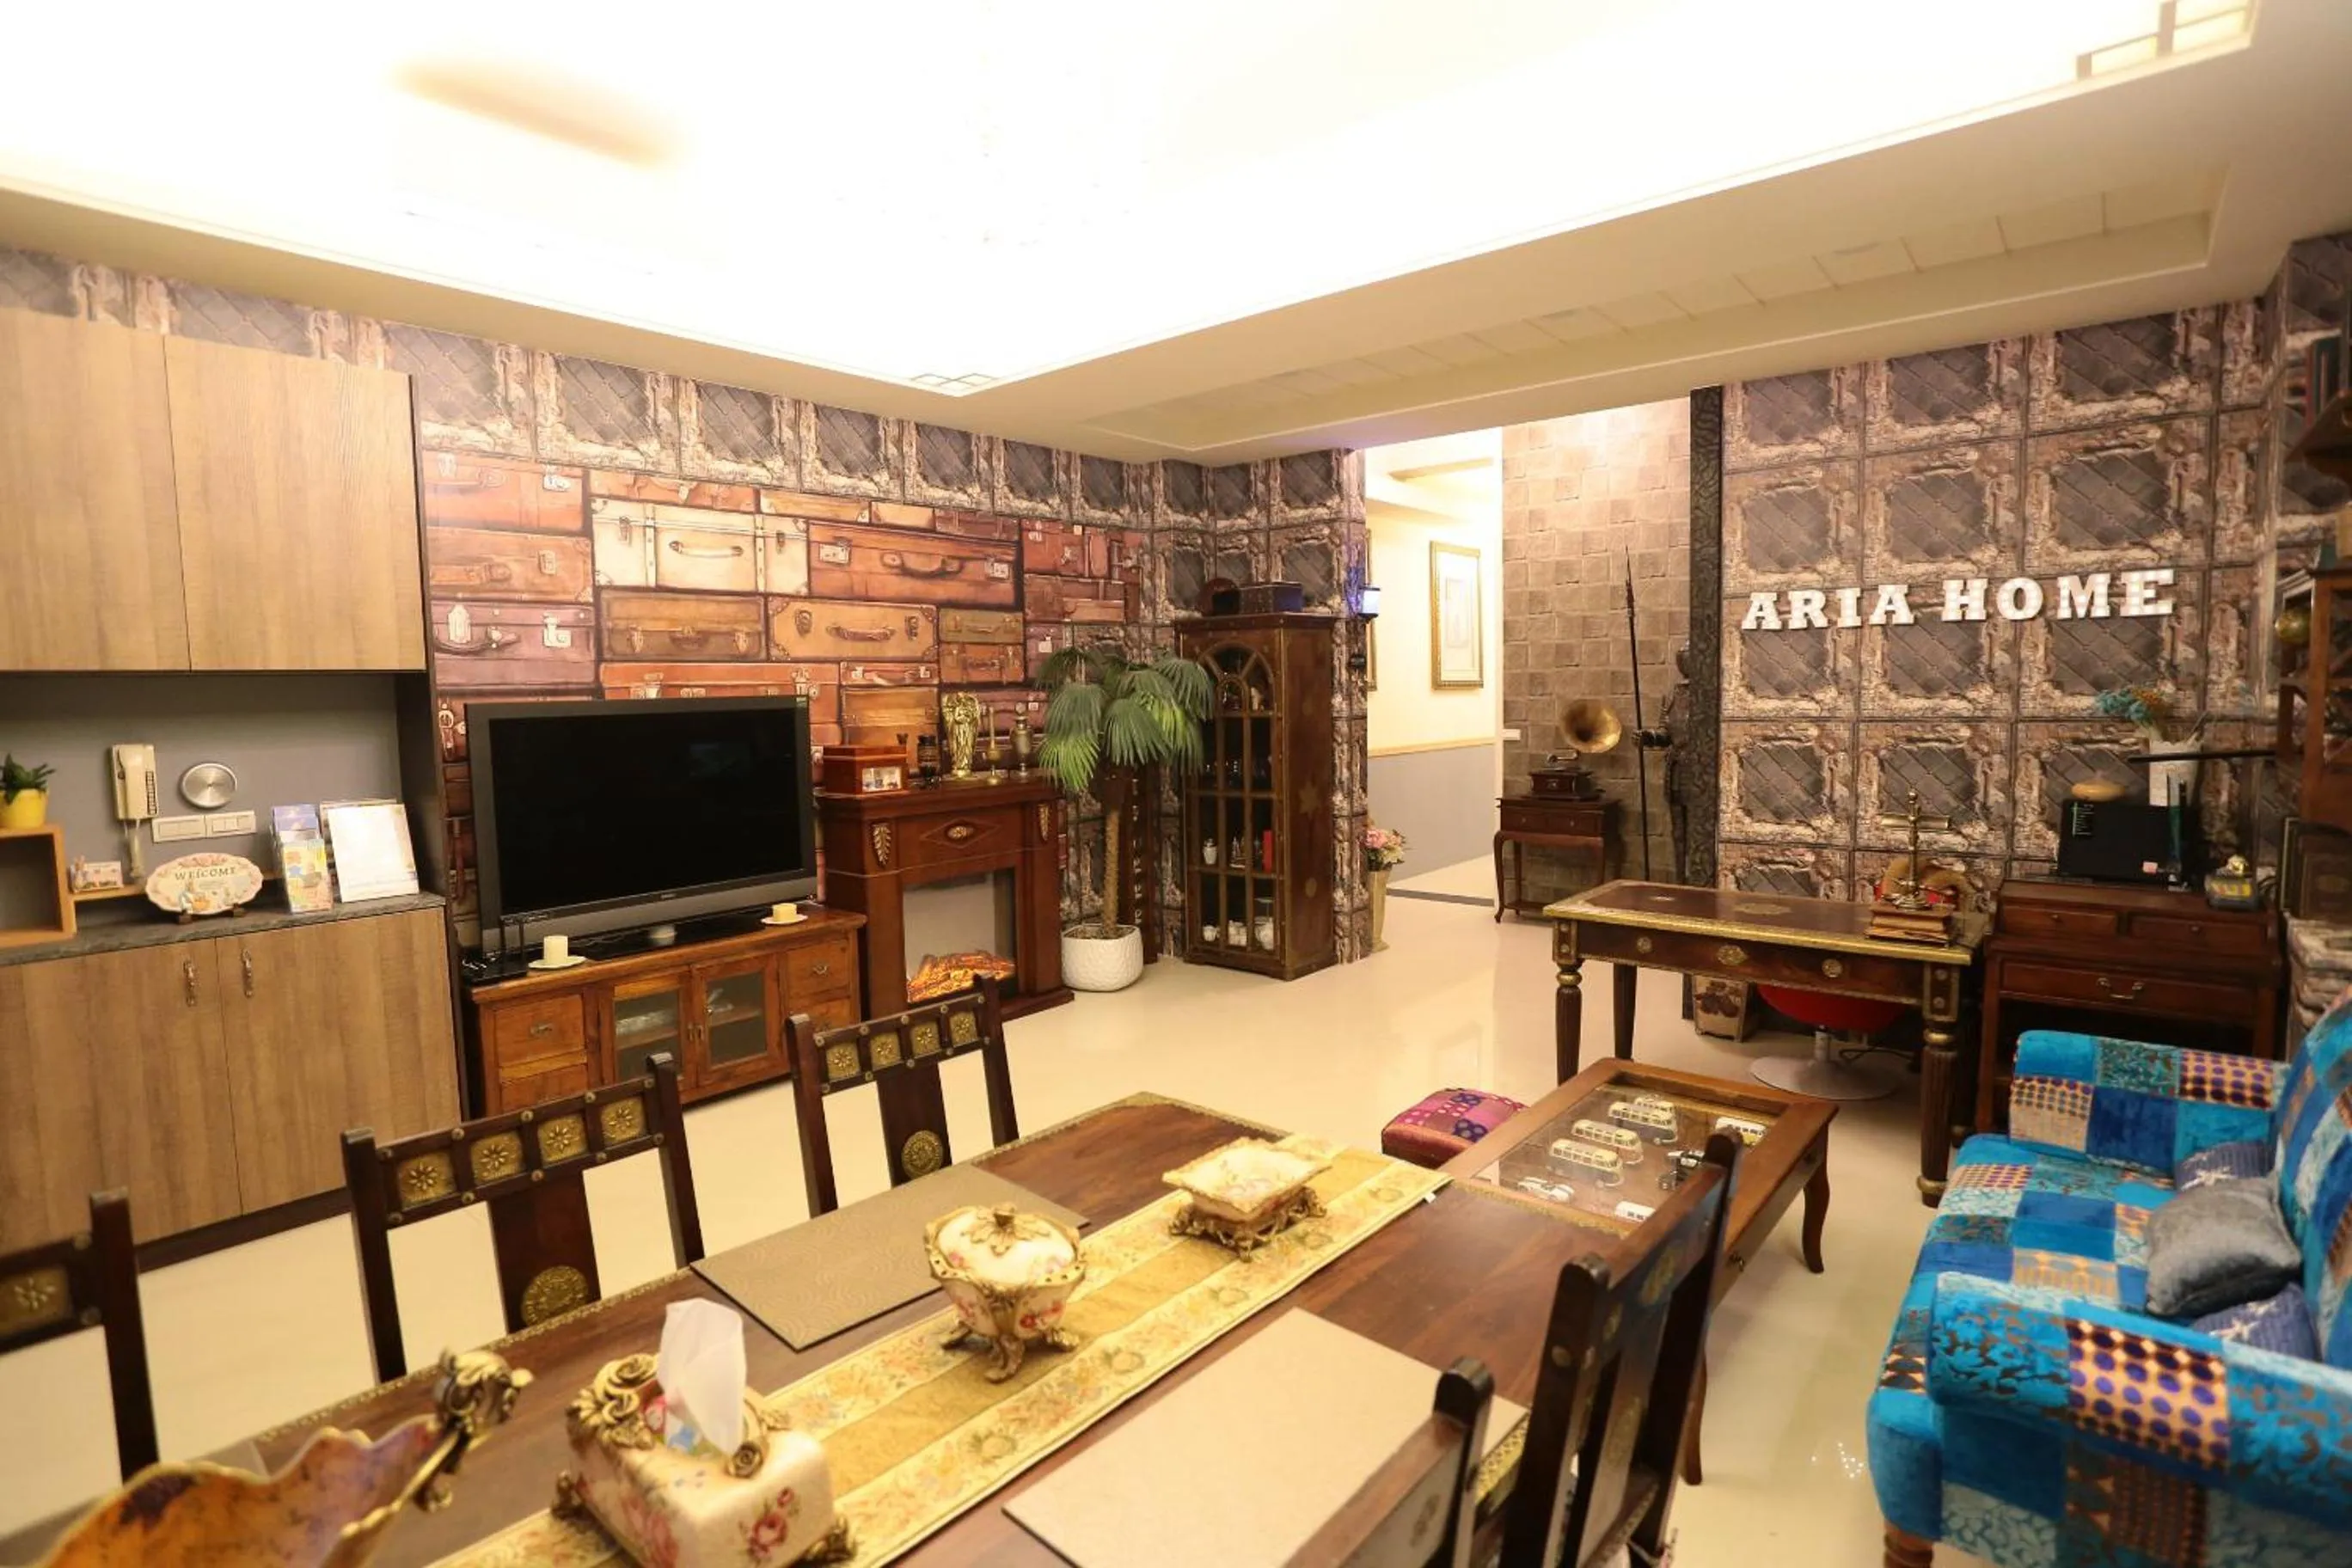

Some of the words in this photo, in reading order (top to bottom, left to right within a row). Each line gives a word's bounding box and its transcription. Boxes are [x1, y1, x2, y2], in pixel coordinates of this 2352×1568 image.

[1741, 584, 1915, 630] ARIA
[1940, 569, 2175, 622] HOME
[175, 867, 236, 880] WELCOME
